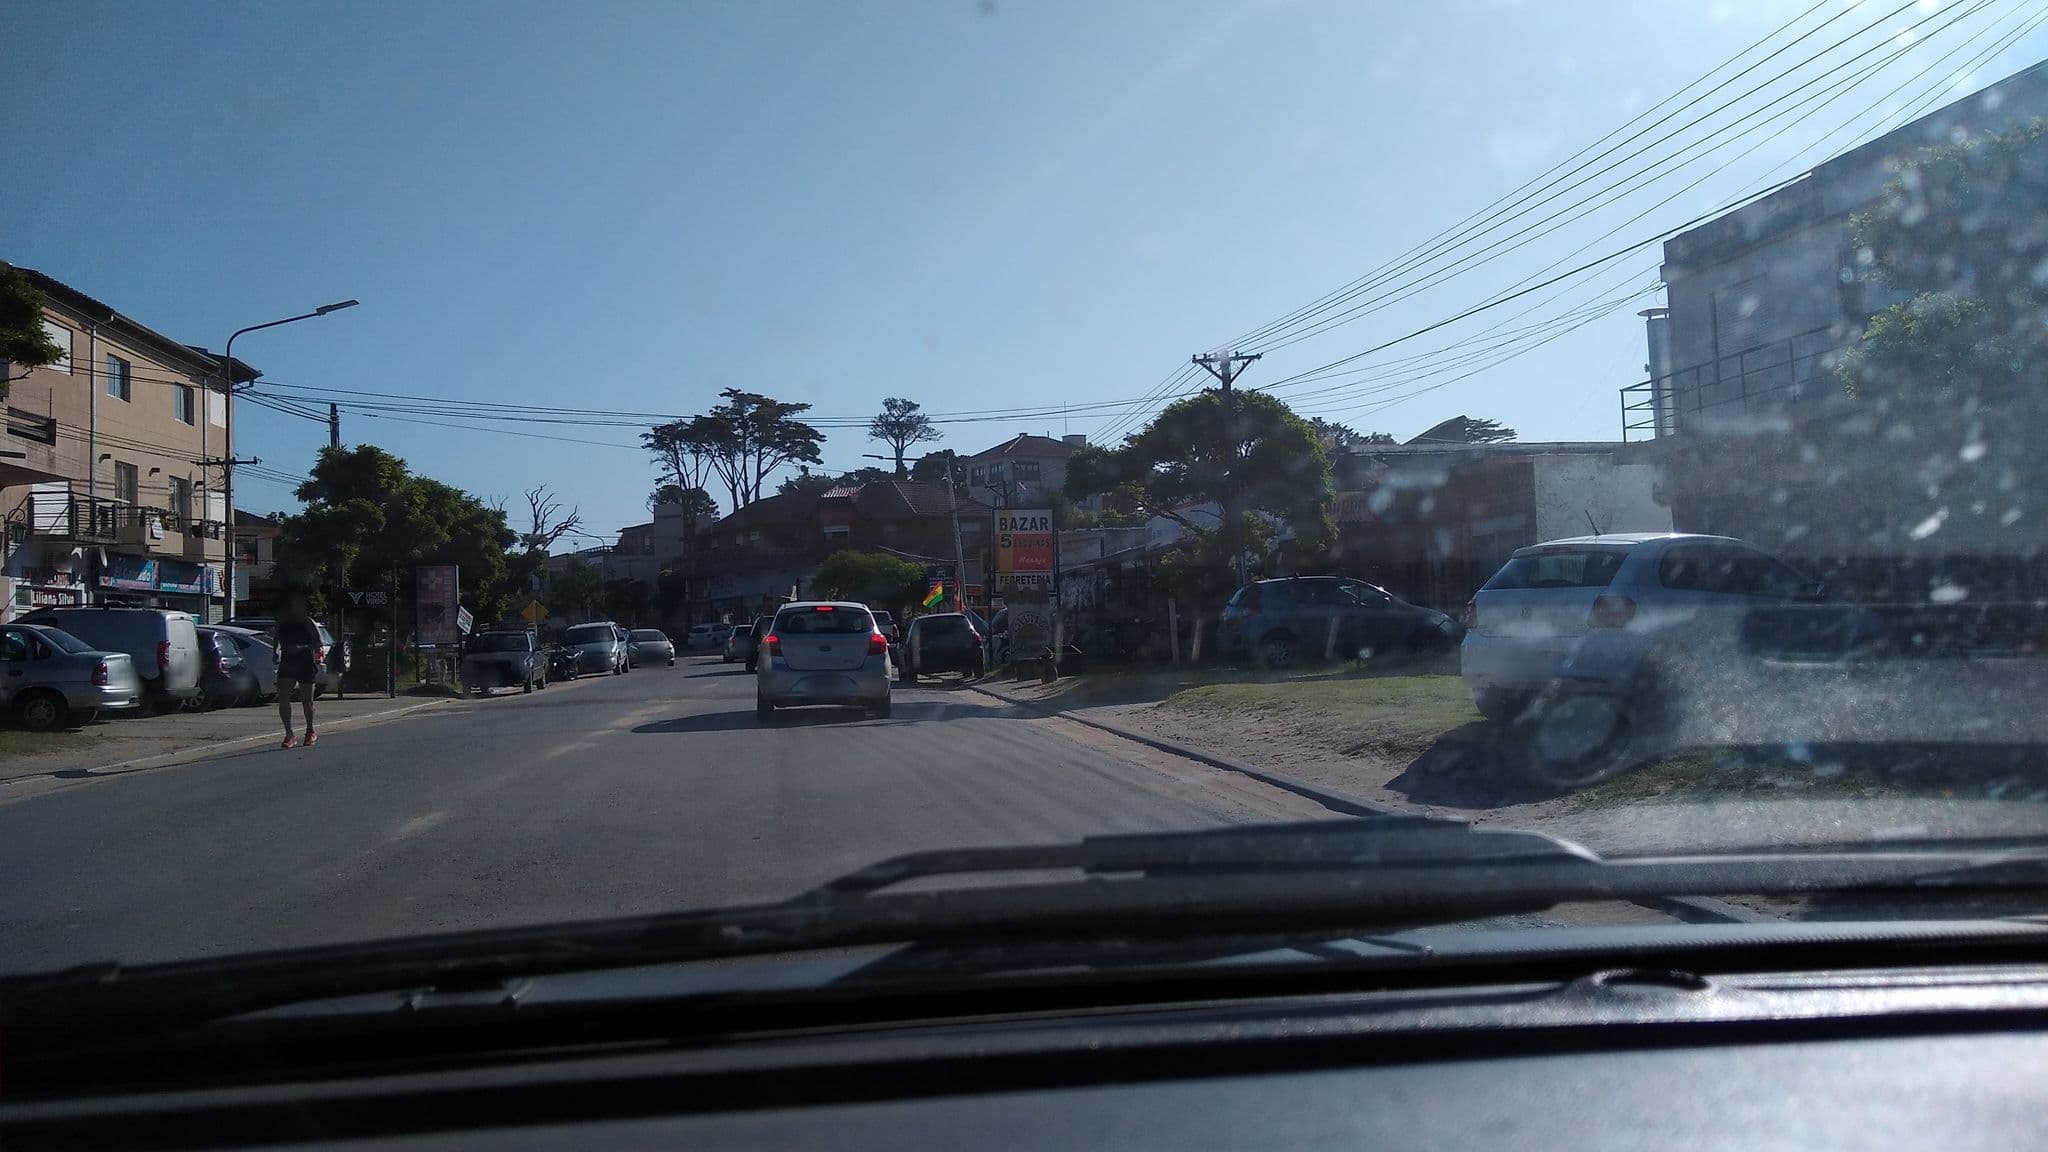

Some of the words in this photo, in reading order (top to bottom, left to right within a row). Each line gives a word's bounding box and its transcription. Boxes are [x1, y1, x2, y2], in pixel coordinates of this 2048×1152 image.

[999, 517, 1049, 531] BAZAR
[1001, 533, 1012, 548] 5
[999, 575, 1051, 585] FERRETERIA
[32, 590, 57, 605] Liliana
[58, 592, 75, 605] Silva
[365, 591, 387, 599] HOTEL
